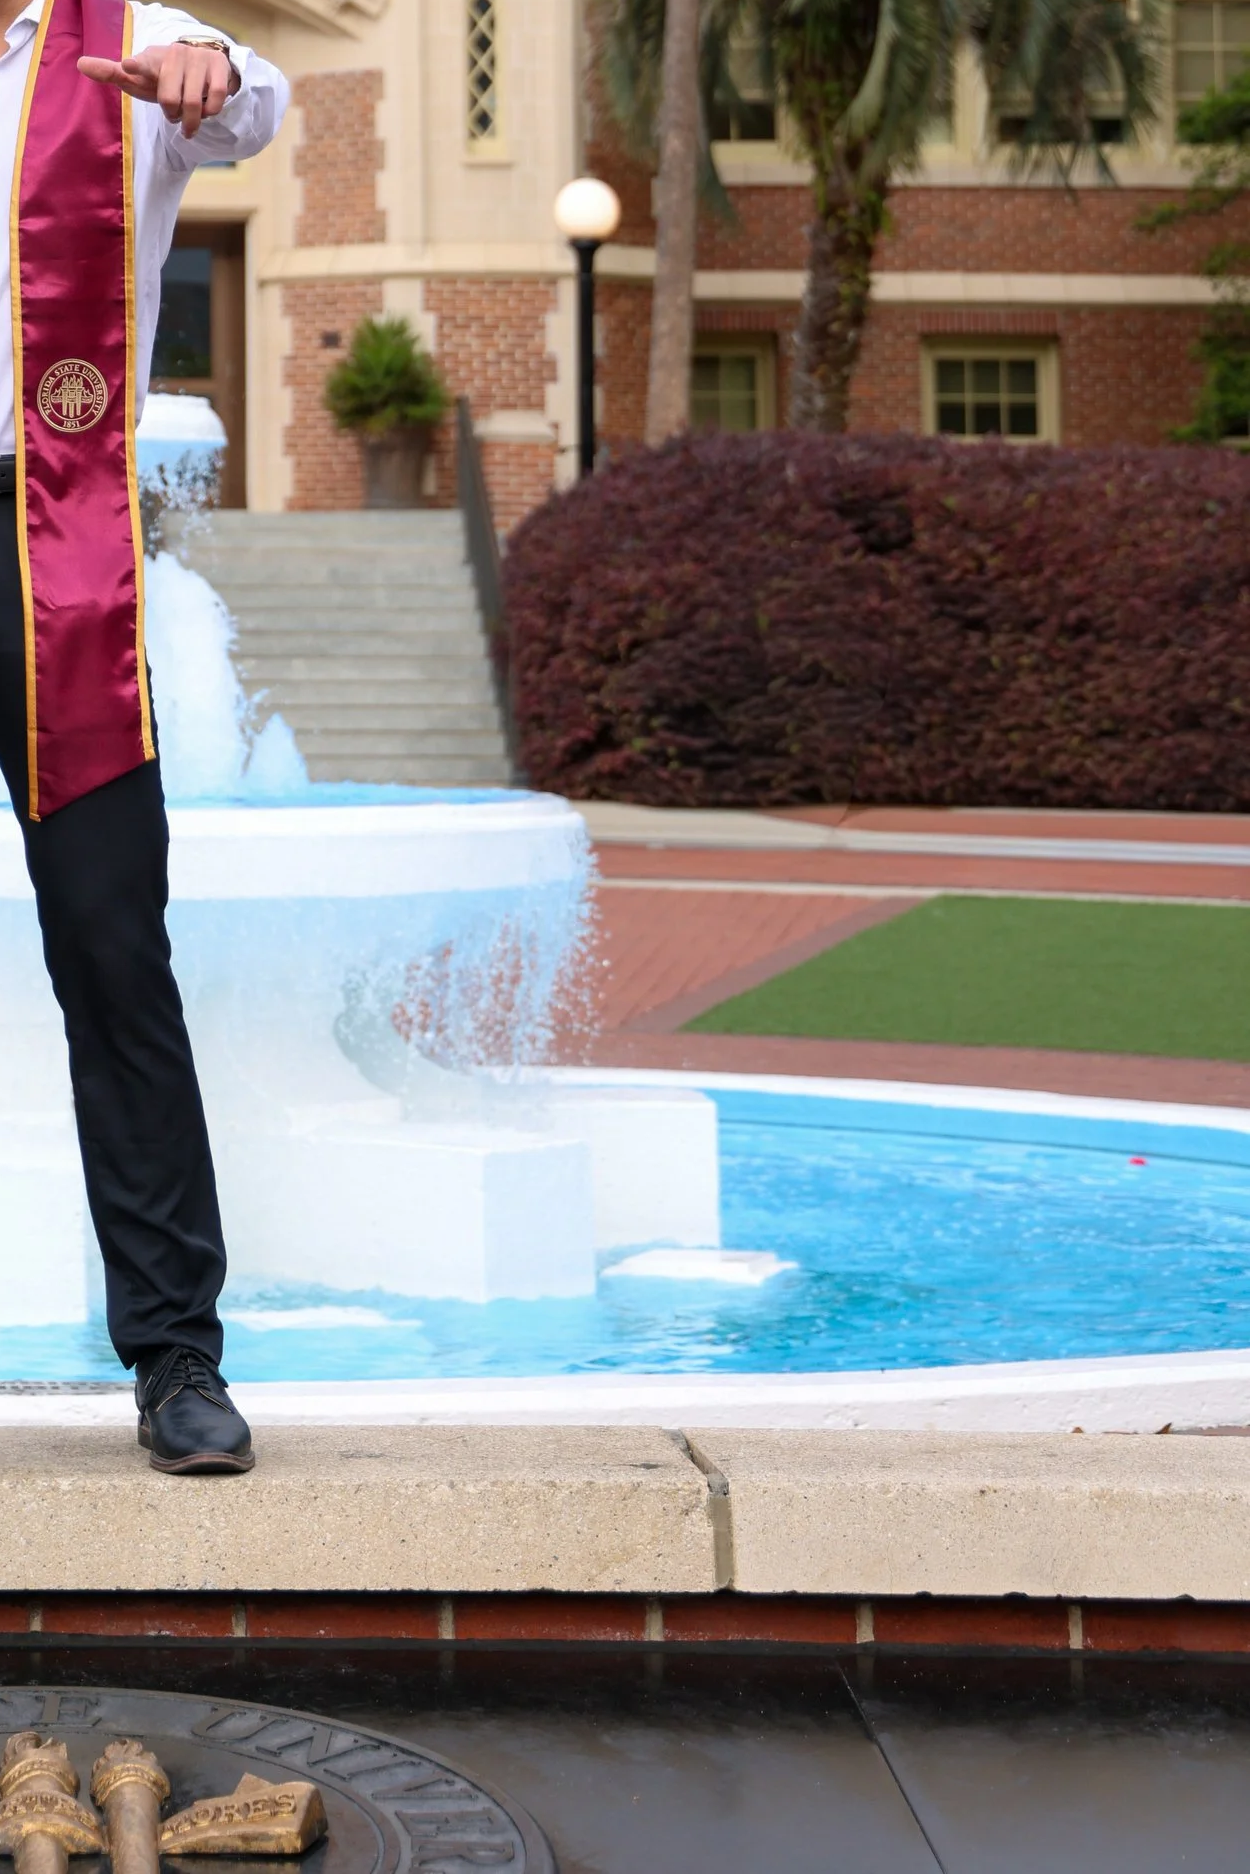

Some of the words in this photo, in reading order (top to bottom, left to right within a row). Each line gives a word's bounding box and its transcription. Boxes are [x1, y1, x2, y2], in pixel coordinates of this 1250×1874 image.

[41, 376, 55, 416] FLORIDA
[54, 364, 80, 376] STATE
[82, 366, 104, 416] UNIVERSITY
[63, 420, 80, 428] 1851
[190, 1706, 515, 1873] UNIVER
